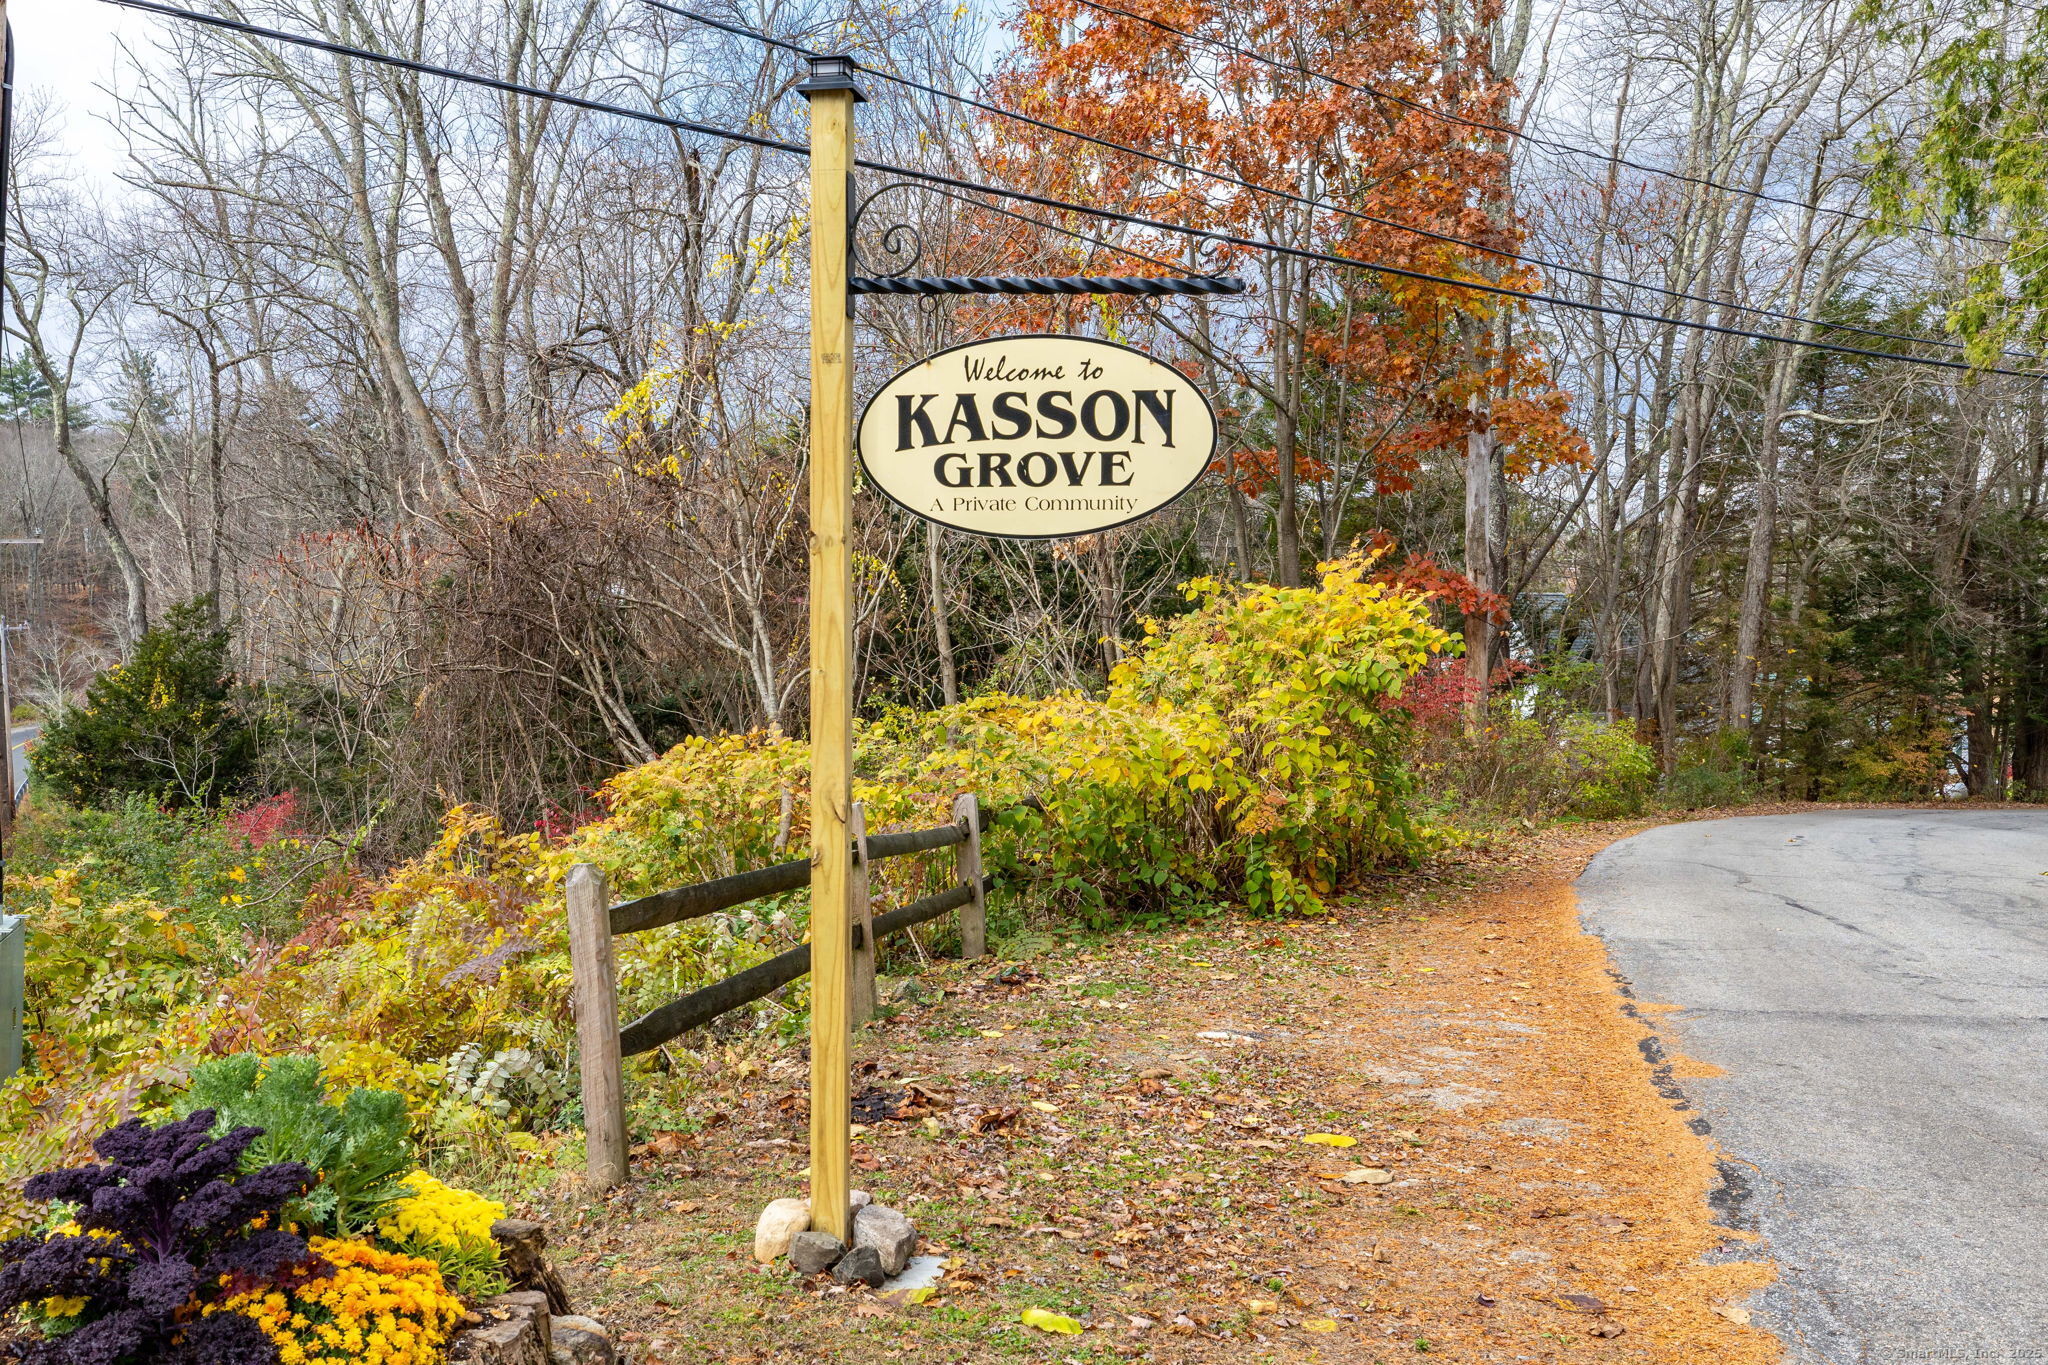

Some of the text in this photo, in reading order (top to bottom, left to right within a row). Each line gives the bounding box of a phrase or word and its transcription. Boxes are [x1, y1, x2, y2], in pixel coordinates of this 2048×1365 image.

[964, 355, 1104, 382] Welcome to
[895, 389, 1177, 452] KASSON
[933, 451, 1135, 488] GROVE
[930, 495, 1138, 514] A Private Community
